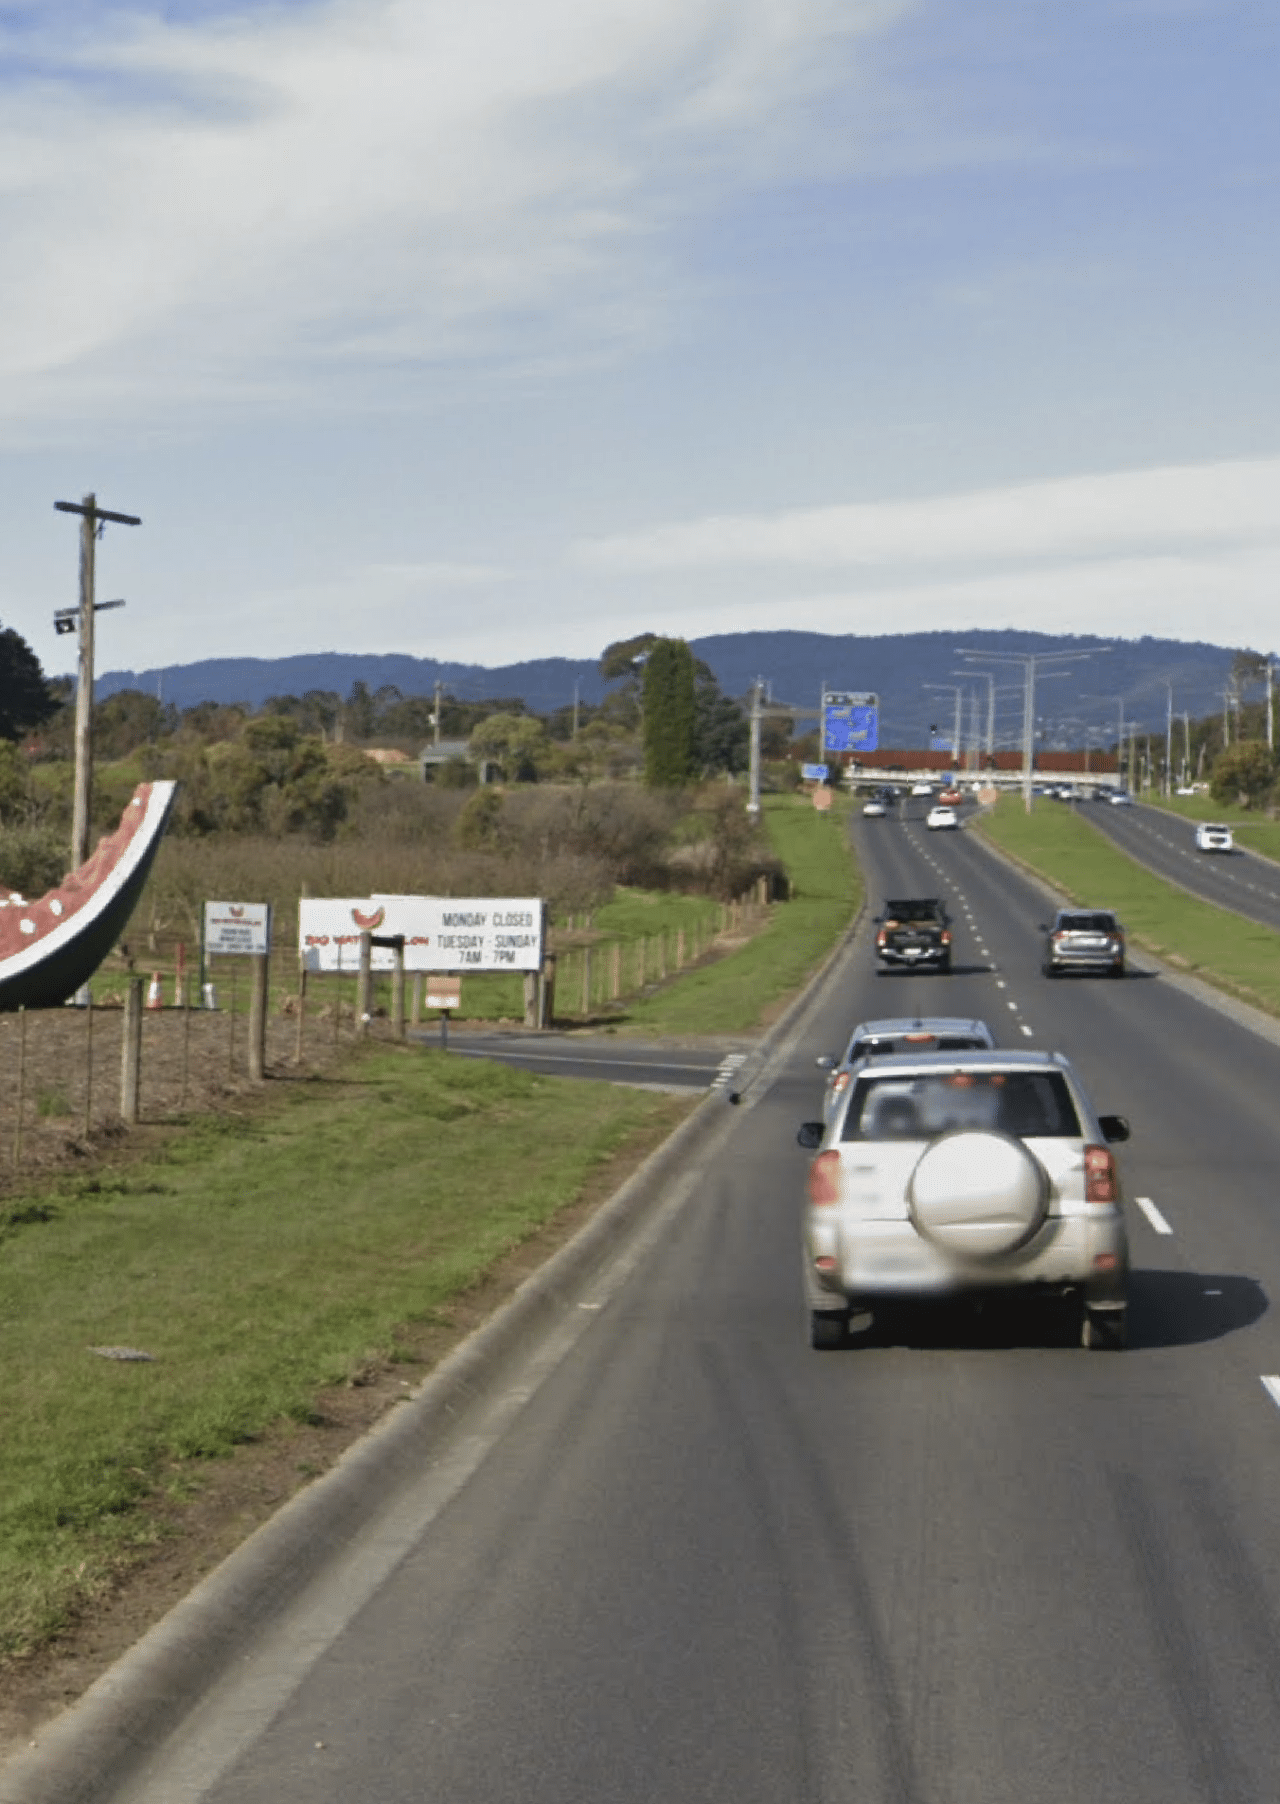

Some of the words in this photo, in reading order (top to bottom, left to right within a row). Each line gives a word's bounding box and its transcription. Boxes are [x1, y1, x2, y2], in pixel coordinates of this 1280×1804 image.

[442, 912, 487, 927] MONDAY
[493, 912, 533, 927] CLOSED
[438, 934, 484, 949] TUESDAY
[495, 934, 537, 948] SUNDAY
[459, 951, 482, 963] 7AM
[494, 951, 516, 963] 7PM
